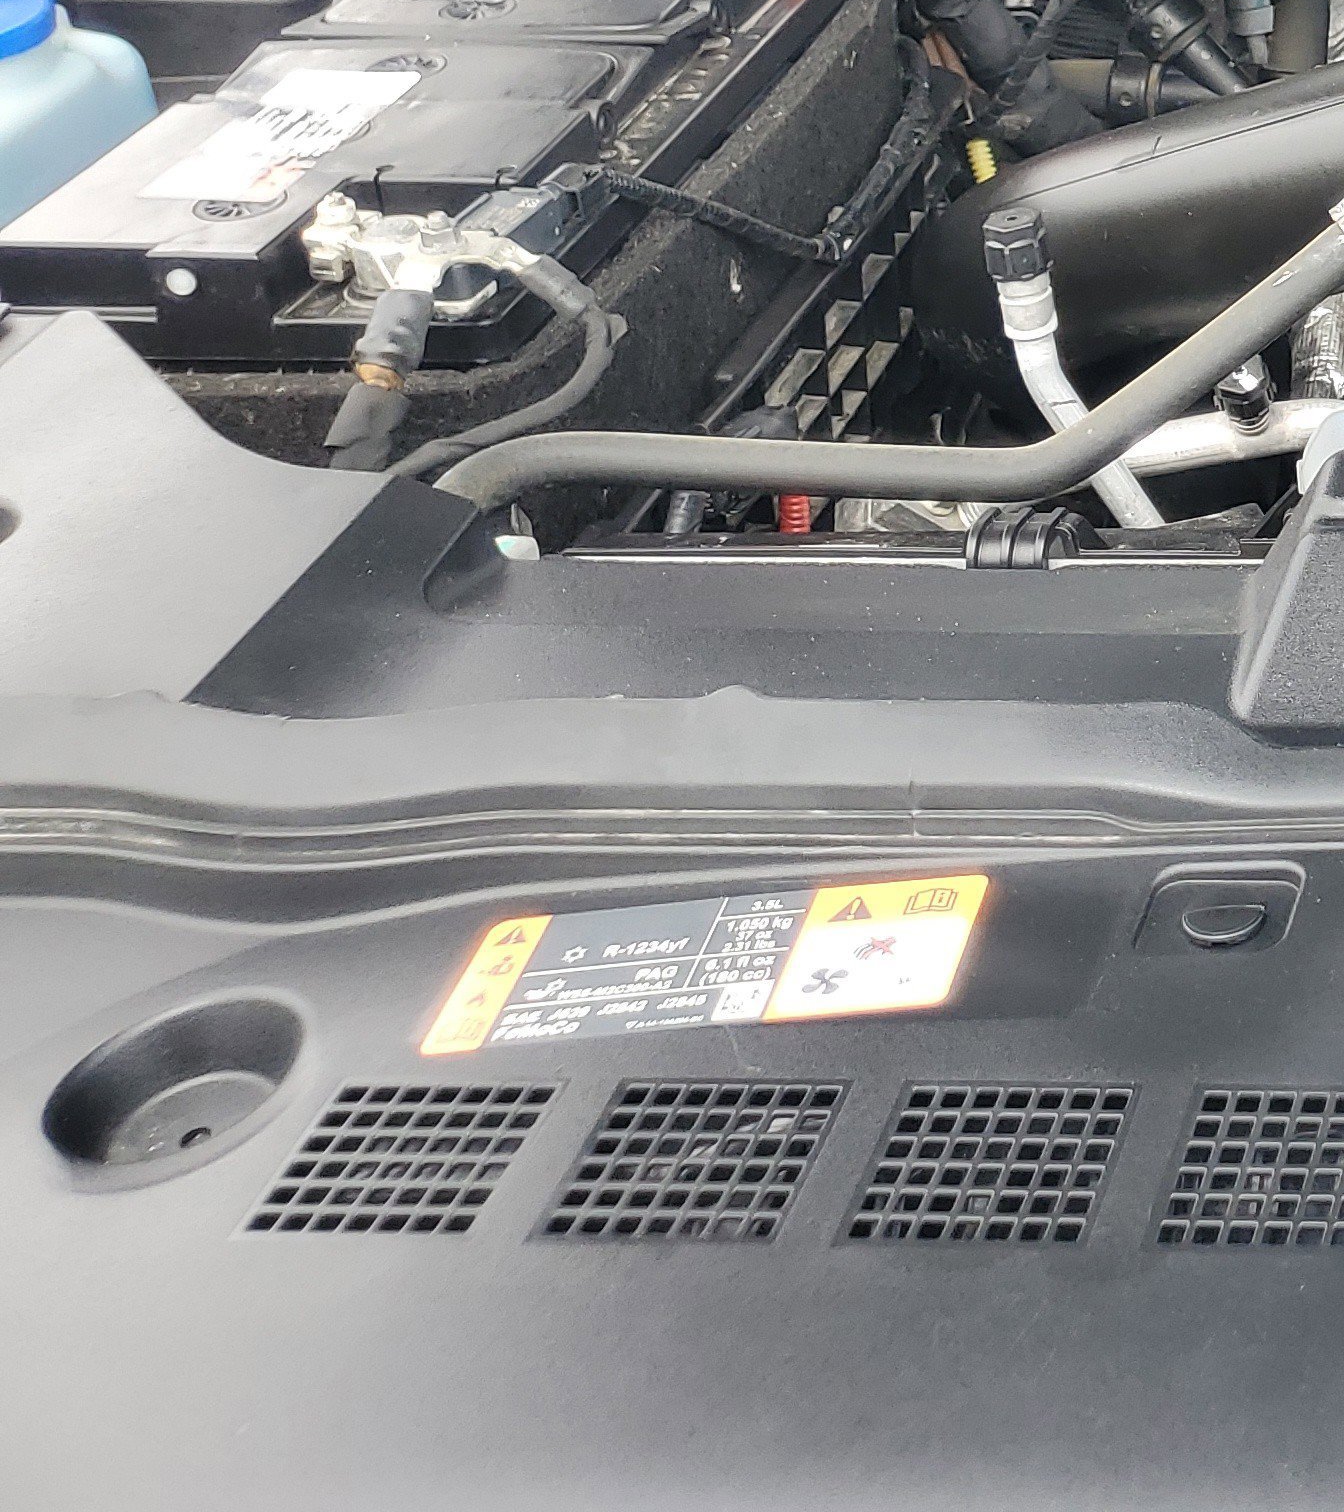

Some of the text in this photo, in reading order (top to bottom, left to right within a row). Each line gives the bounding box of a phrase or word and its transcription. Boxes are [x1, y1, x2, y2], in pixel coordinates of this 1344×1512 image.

[727, 916, 794, 933] 1.050 kg
[735, 930, 774, 942] 37 oz
[602, 937, 691, 958] R-1234yf
[721, 939, 776, 953] 2.31 lbs
[752, 955, 777, 967] oz
[634, 965, 679, 982] PAG
[741, 966, 772, 981] cc)
